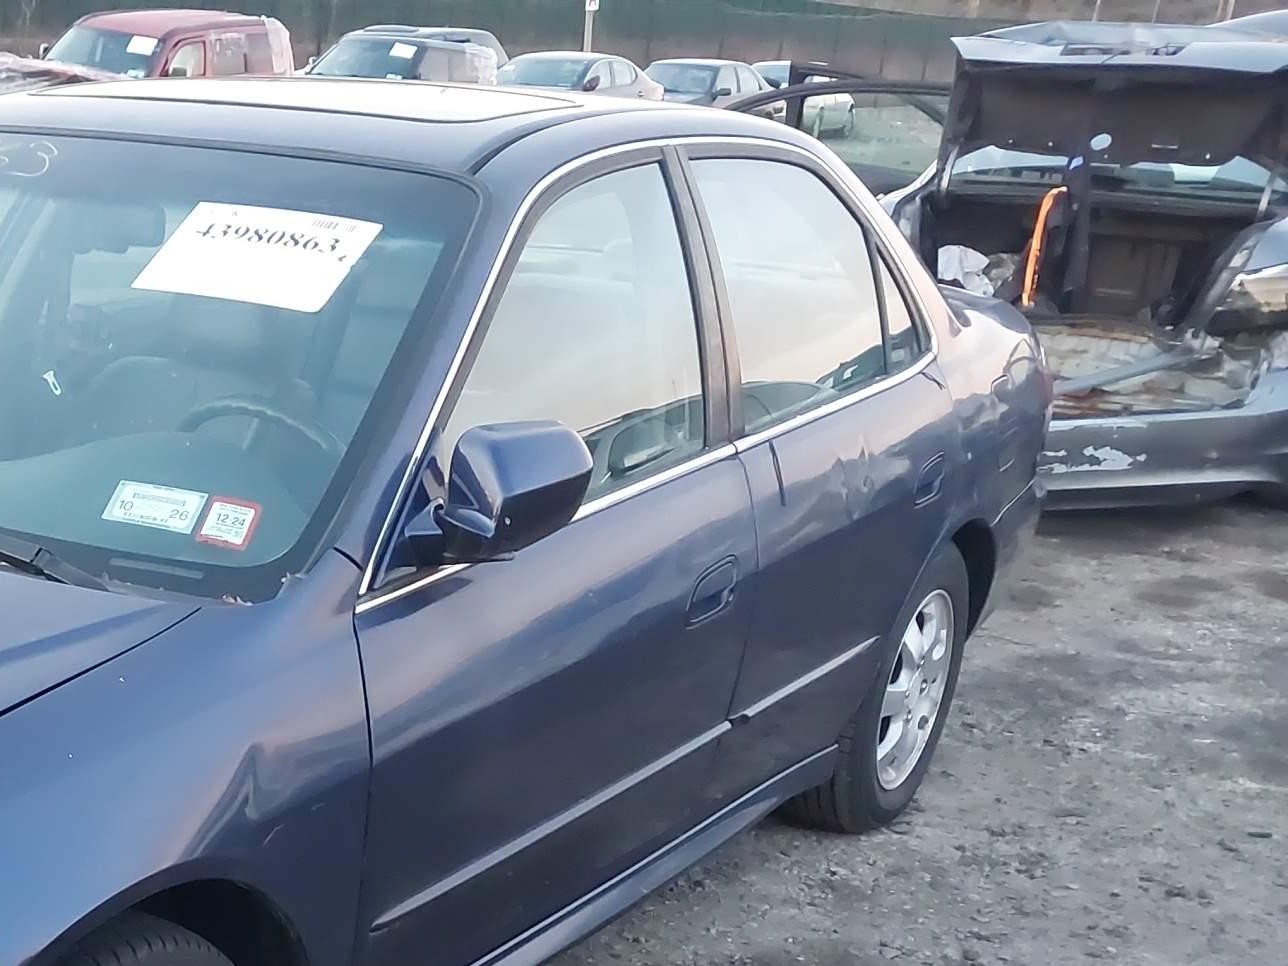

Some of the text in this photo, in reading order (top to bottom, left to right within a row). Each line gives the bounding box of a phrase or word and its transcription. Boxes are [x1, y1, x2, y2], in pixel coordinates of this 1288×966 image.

[196, 223, 341, 253] 43980863
[119, 499, 134, 511] 10
[168, 508, 190, 521] 26
[216, 512, 229, 523] 12
